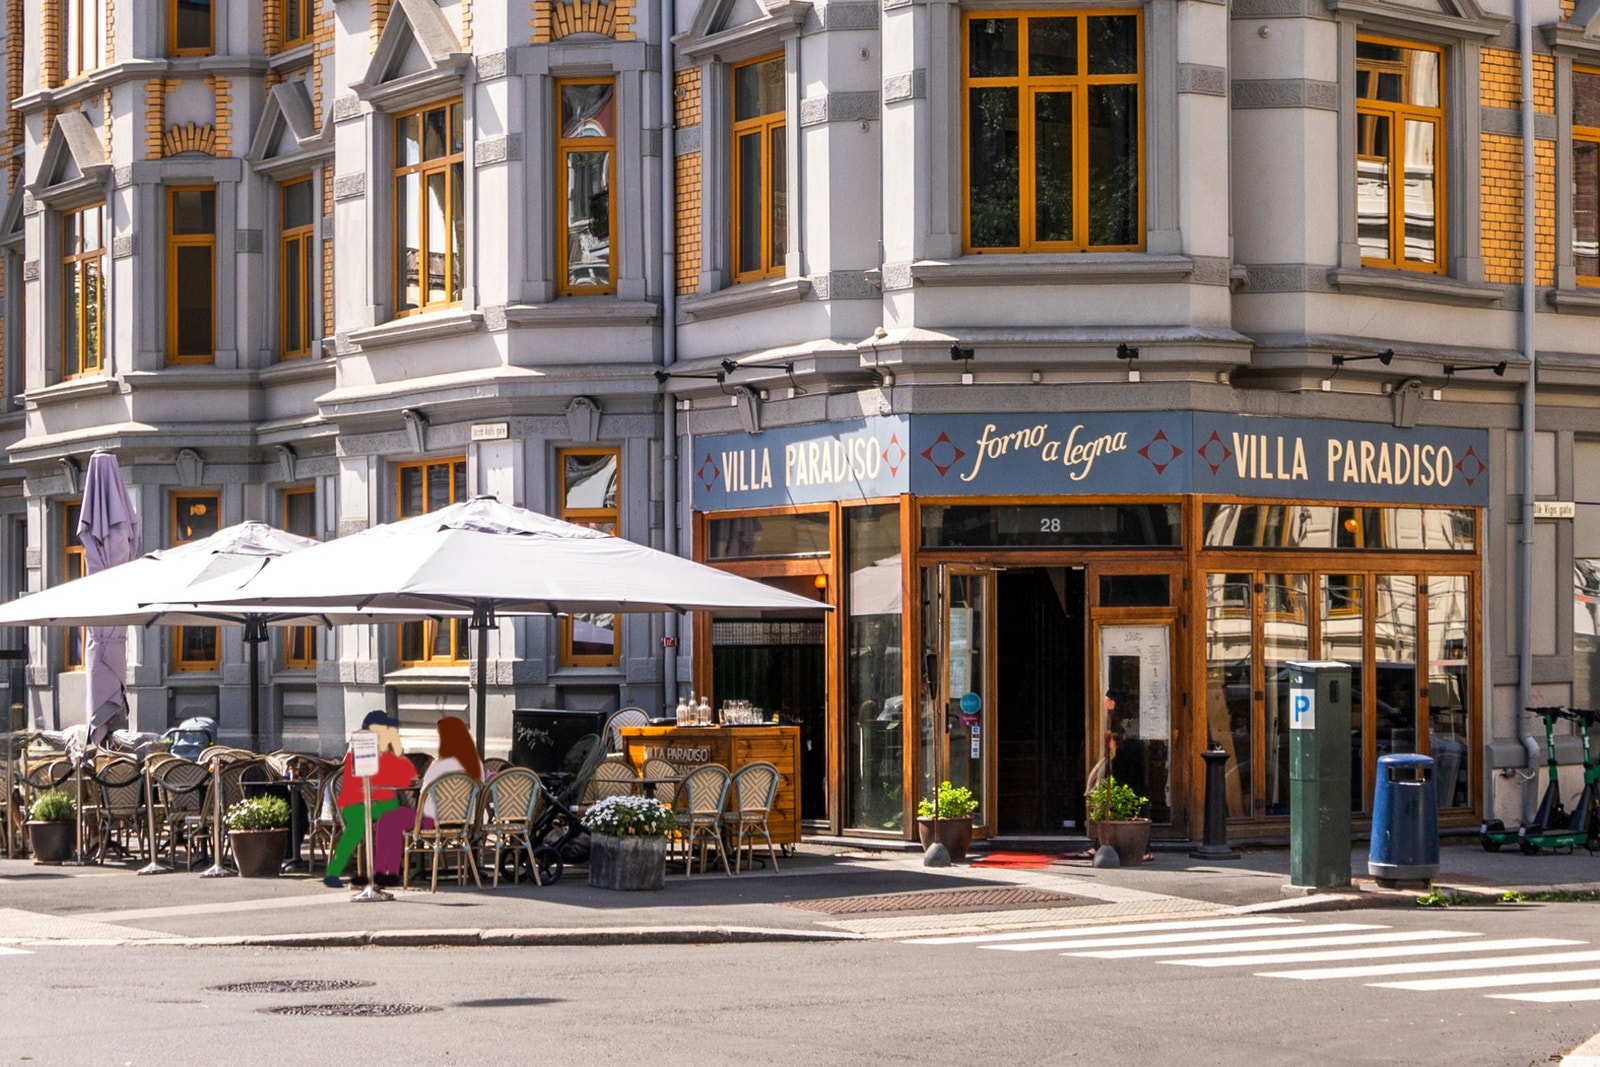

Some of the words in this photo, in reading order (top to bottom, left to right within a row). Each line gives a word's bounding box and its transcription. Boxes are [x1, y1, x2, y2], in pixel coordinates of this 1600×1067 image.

[722, 447, 772, 493] VILLA
[785, 436, 881, 487] PARADISO
[960, 423, 1048, 481] forno
[1041, 440, 1061, 462] a
[1063, 424, 1128, 481] legna
[1232, 432, 1309, 481] VILLA
[1327, 438, 1454, 487] PARADISO
[1559, 505, 1572, 516] gate
[1040, 518, 1061, 533] 28
[1294, 695, 1311, 722] P
[667, 747, 708, 762] PARADISO
